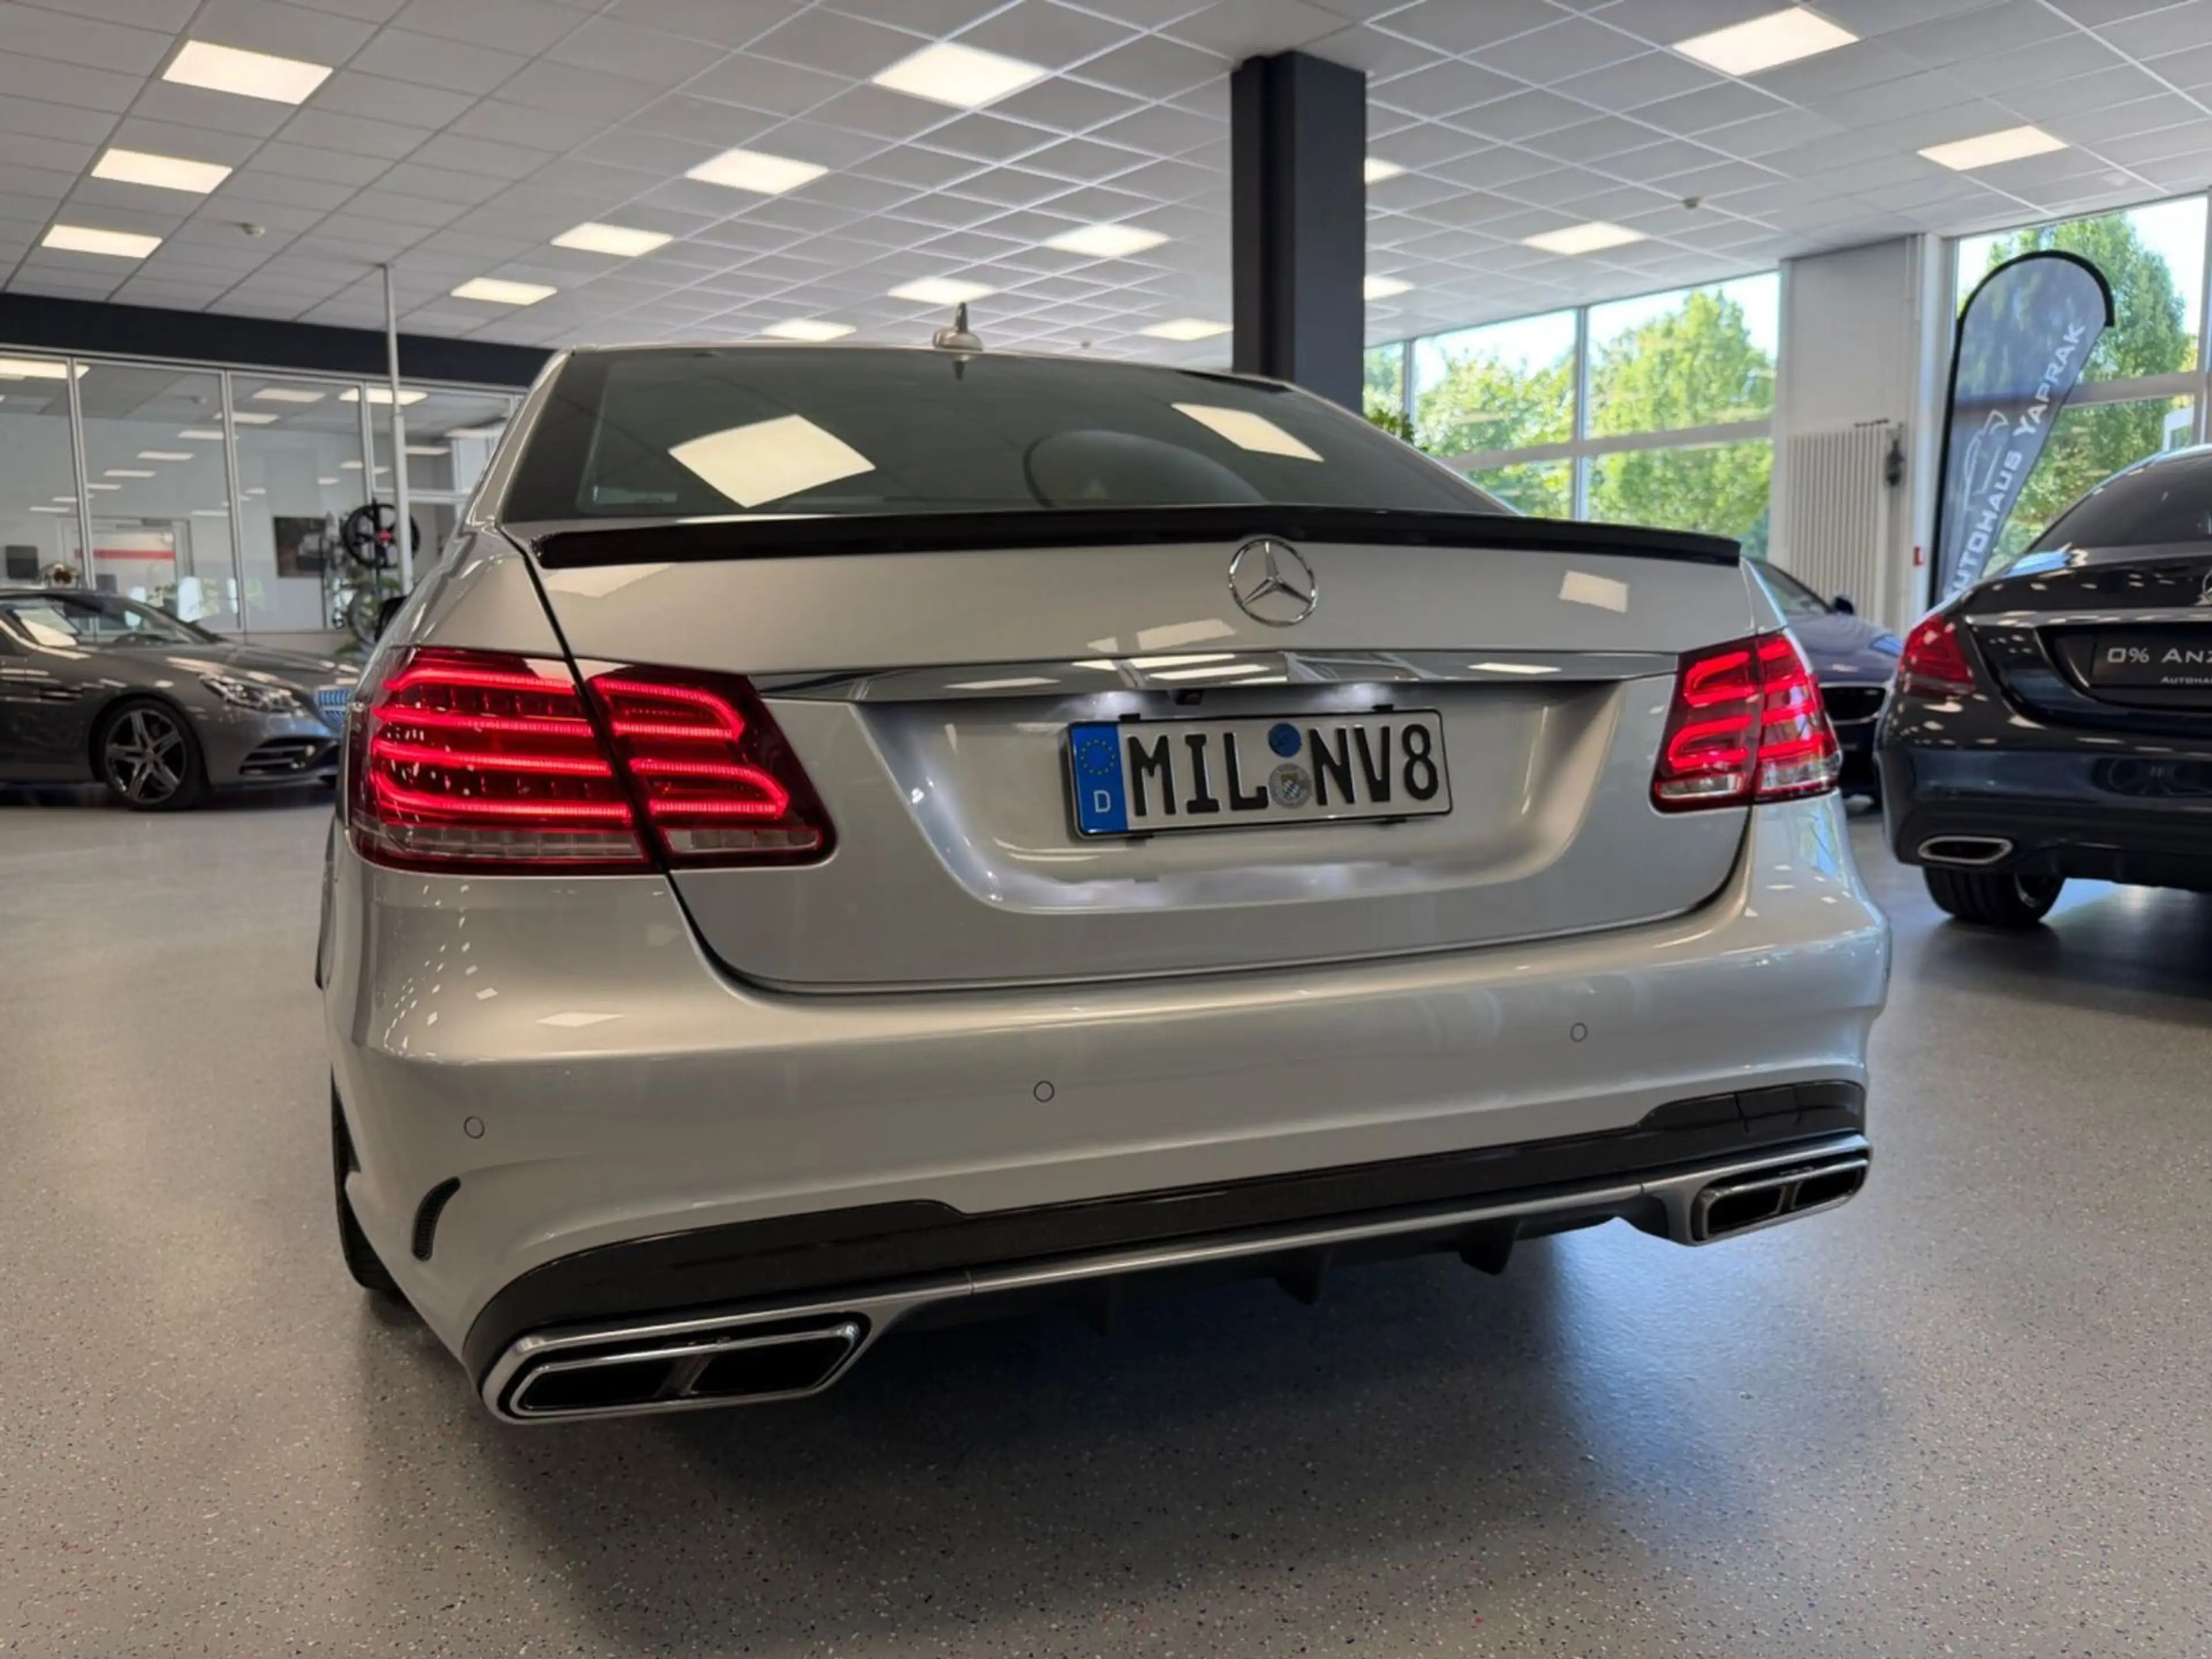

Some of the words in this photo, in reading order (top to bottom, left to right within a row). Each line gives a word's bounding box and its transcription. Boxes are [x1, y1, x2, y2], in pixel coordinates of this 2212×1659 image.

[2012, 323, 2086, 438] YAPRAK
[2107, 647, 2150, 663] 0%
[2161, 676, 2212, 685] AUTOHA
[1127, 732, 1269, 817] MIL
[1309, 724, 1438, 805] NV8
[1094, 790, 1111, 813] D
